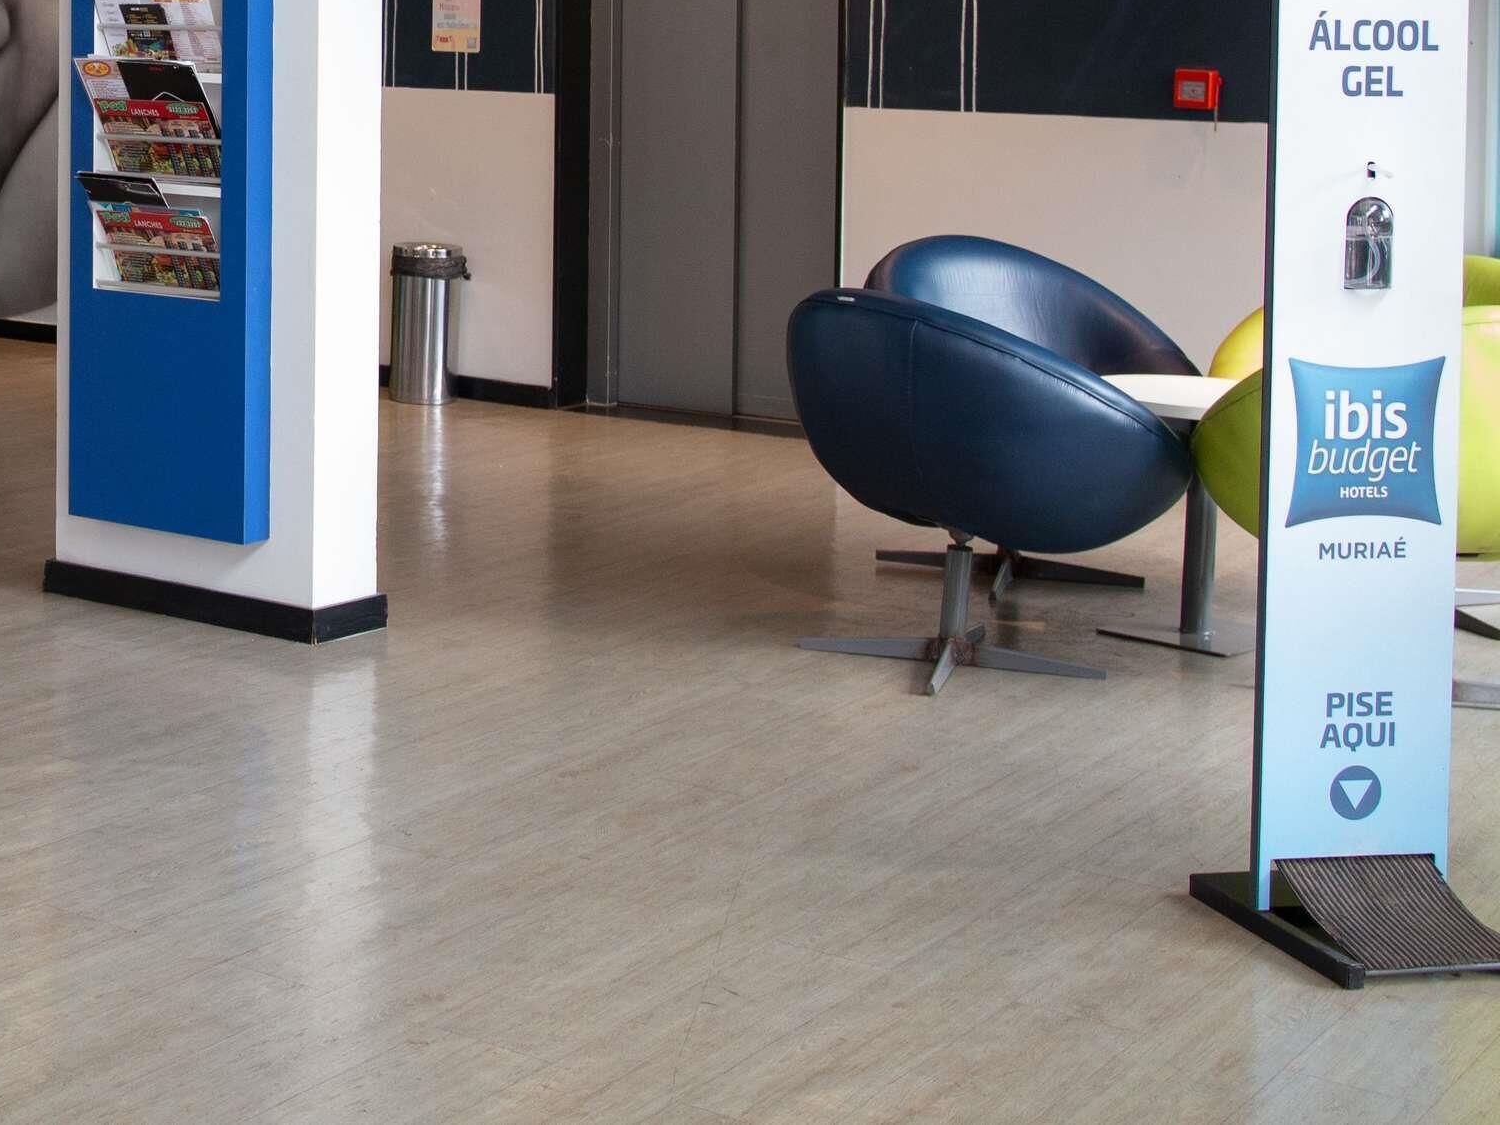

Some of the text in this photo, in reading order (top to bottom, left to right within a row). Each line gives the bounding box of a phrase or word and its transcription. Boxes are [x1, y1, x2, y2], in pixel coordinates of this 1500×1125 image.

[1308, 10, 1439, 51] ÁLCOOL
[1341, 65, 1404, 97] GEL
[1324, 389, 1409, 440] ibis
[1307, 438, 1422, 483] budget
[1339, 485, 1389, 499] HOTELS
[1318, 536, 1407, 560] MURIAÉ
[1326, 691, 1394, 718] PISE
[1319, 721, 1396, 752] AQUI
